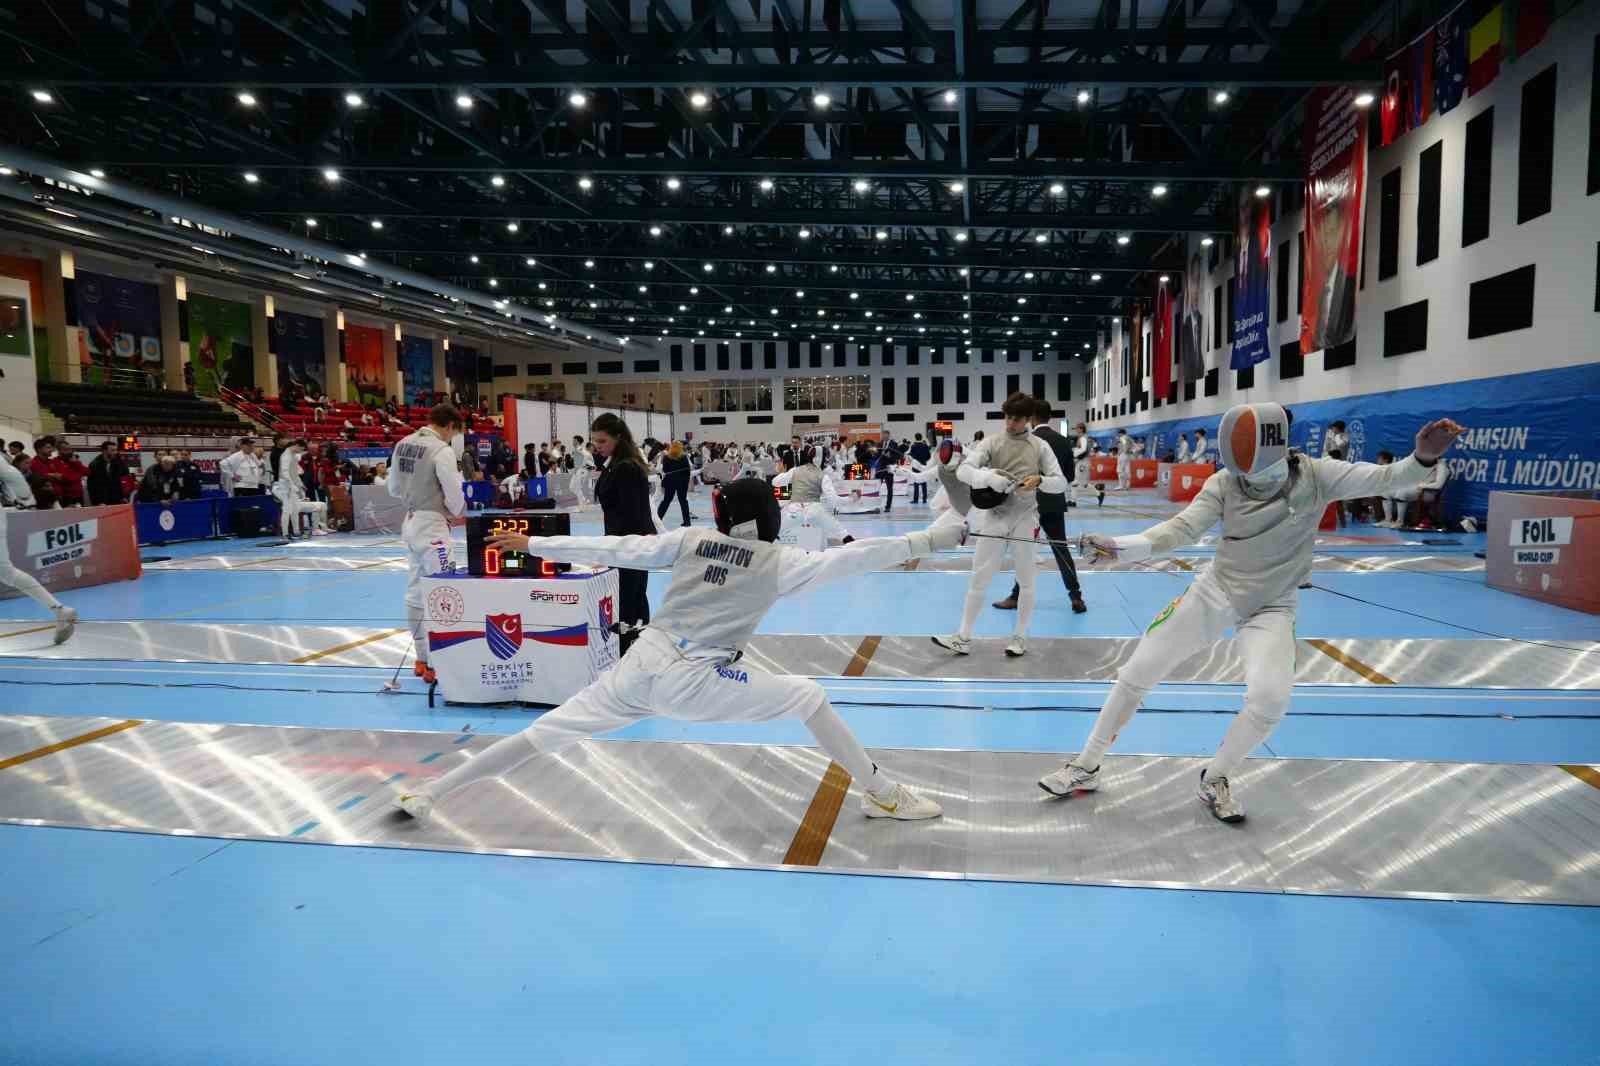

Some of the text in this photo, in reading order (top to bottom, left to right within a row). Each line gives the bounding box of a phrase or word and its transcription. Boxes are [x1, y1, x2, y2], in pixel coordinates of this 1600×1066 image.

[1260, 423, 1286, 446] IRL
[1456, 427, 1529, 450] SAMSUN
[1449, 458, 1488, 482] SPOR
[1493, 454, 1508, 484] İL
[45, 523, 84, 549] FOIL
[1522, 518, 1556, 543] FOIL
[41, 548, 85, 566] WORLD CUP
[485, 548, 499, 574] 0
[695, 539, 754, 568] KHAMITOV
[1517, 551, 1554, 563] WORLD CUP
[703, 565, 728, 585] RUS
